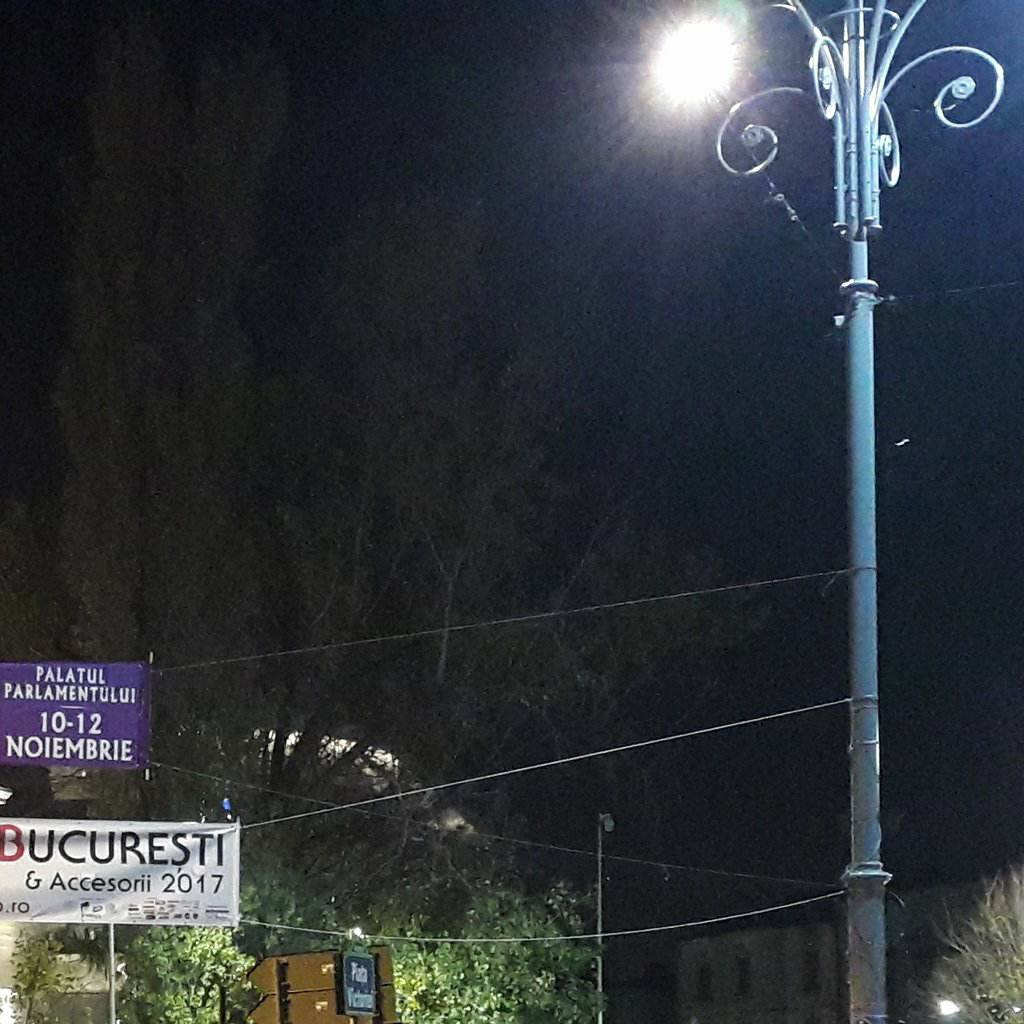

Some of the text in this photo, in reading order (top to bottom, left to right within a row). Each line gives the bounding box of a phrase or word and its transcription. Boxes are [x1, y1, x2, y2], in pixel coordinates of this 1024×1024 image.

[36, 665, 106, 684] PALATUL
[4, 682, 136, 703] PARLAMENTULUI
[40, 711, 102, 735] 10-12
[6, 735, 133, 761] NOIEMBRIE
[25, 870, 224, 895] & Accesorii 2017
